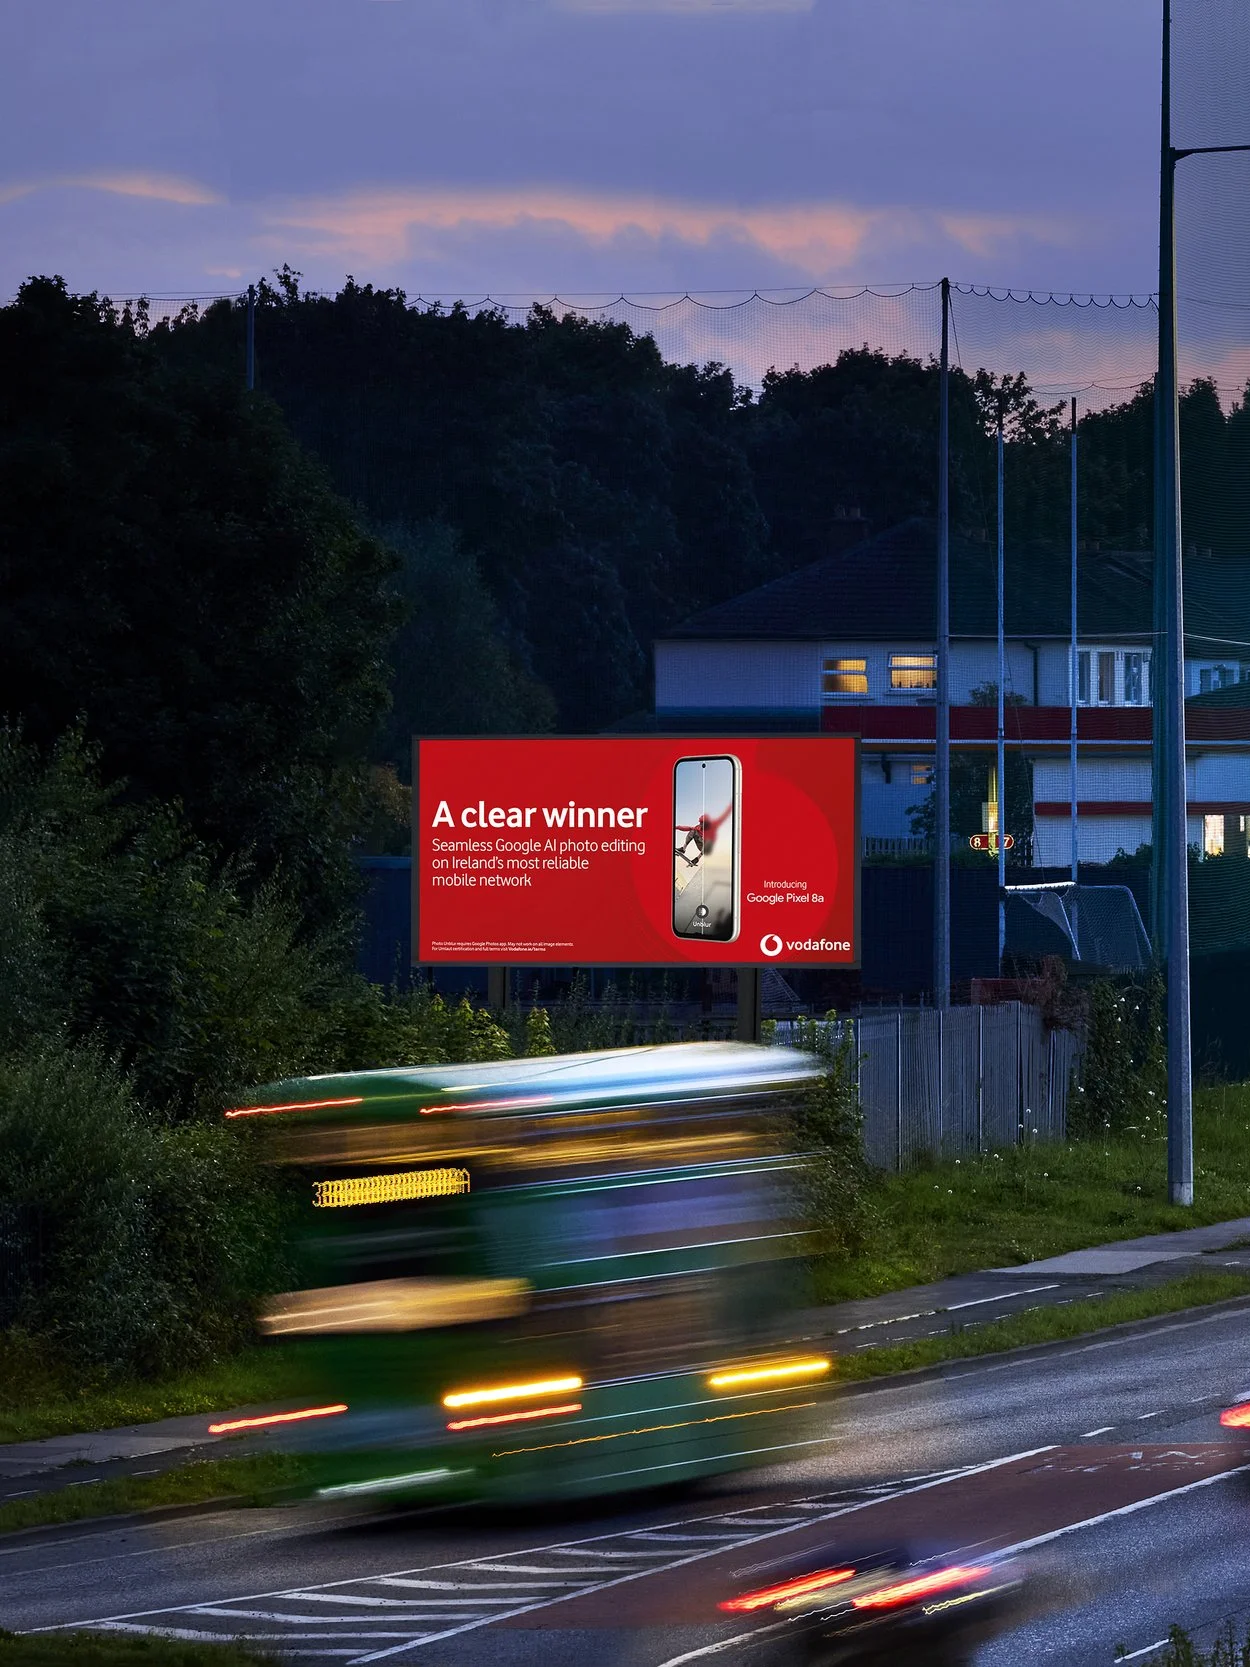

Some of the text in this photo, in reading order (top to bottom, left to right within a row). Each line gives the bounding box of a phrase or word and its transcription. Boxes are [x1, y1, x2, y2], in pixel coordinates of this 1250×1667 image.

[432, 801, 648, 828] A clear winner
[432, 838, 646, 855] Seamless Google AI photo editing
[432, 858, 449, 869] on
[507, 857, 540, 869] most
[542, 856, 589, 869] reliable
[432, 873, 532, 887] mobile network
[763, 880, 807, 890] Introducing
[747, 893, 825, 905] Google Pixel 8a
[786, 938, 851, 951] vodafone
